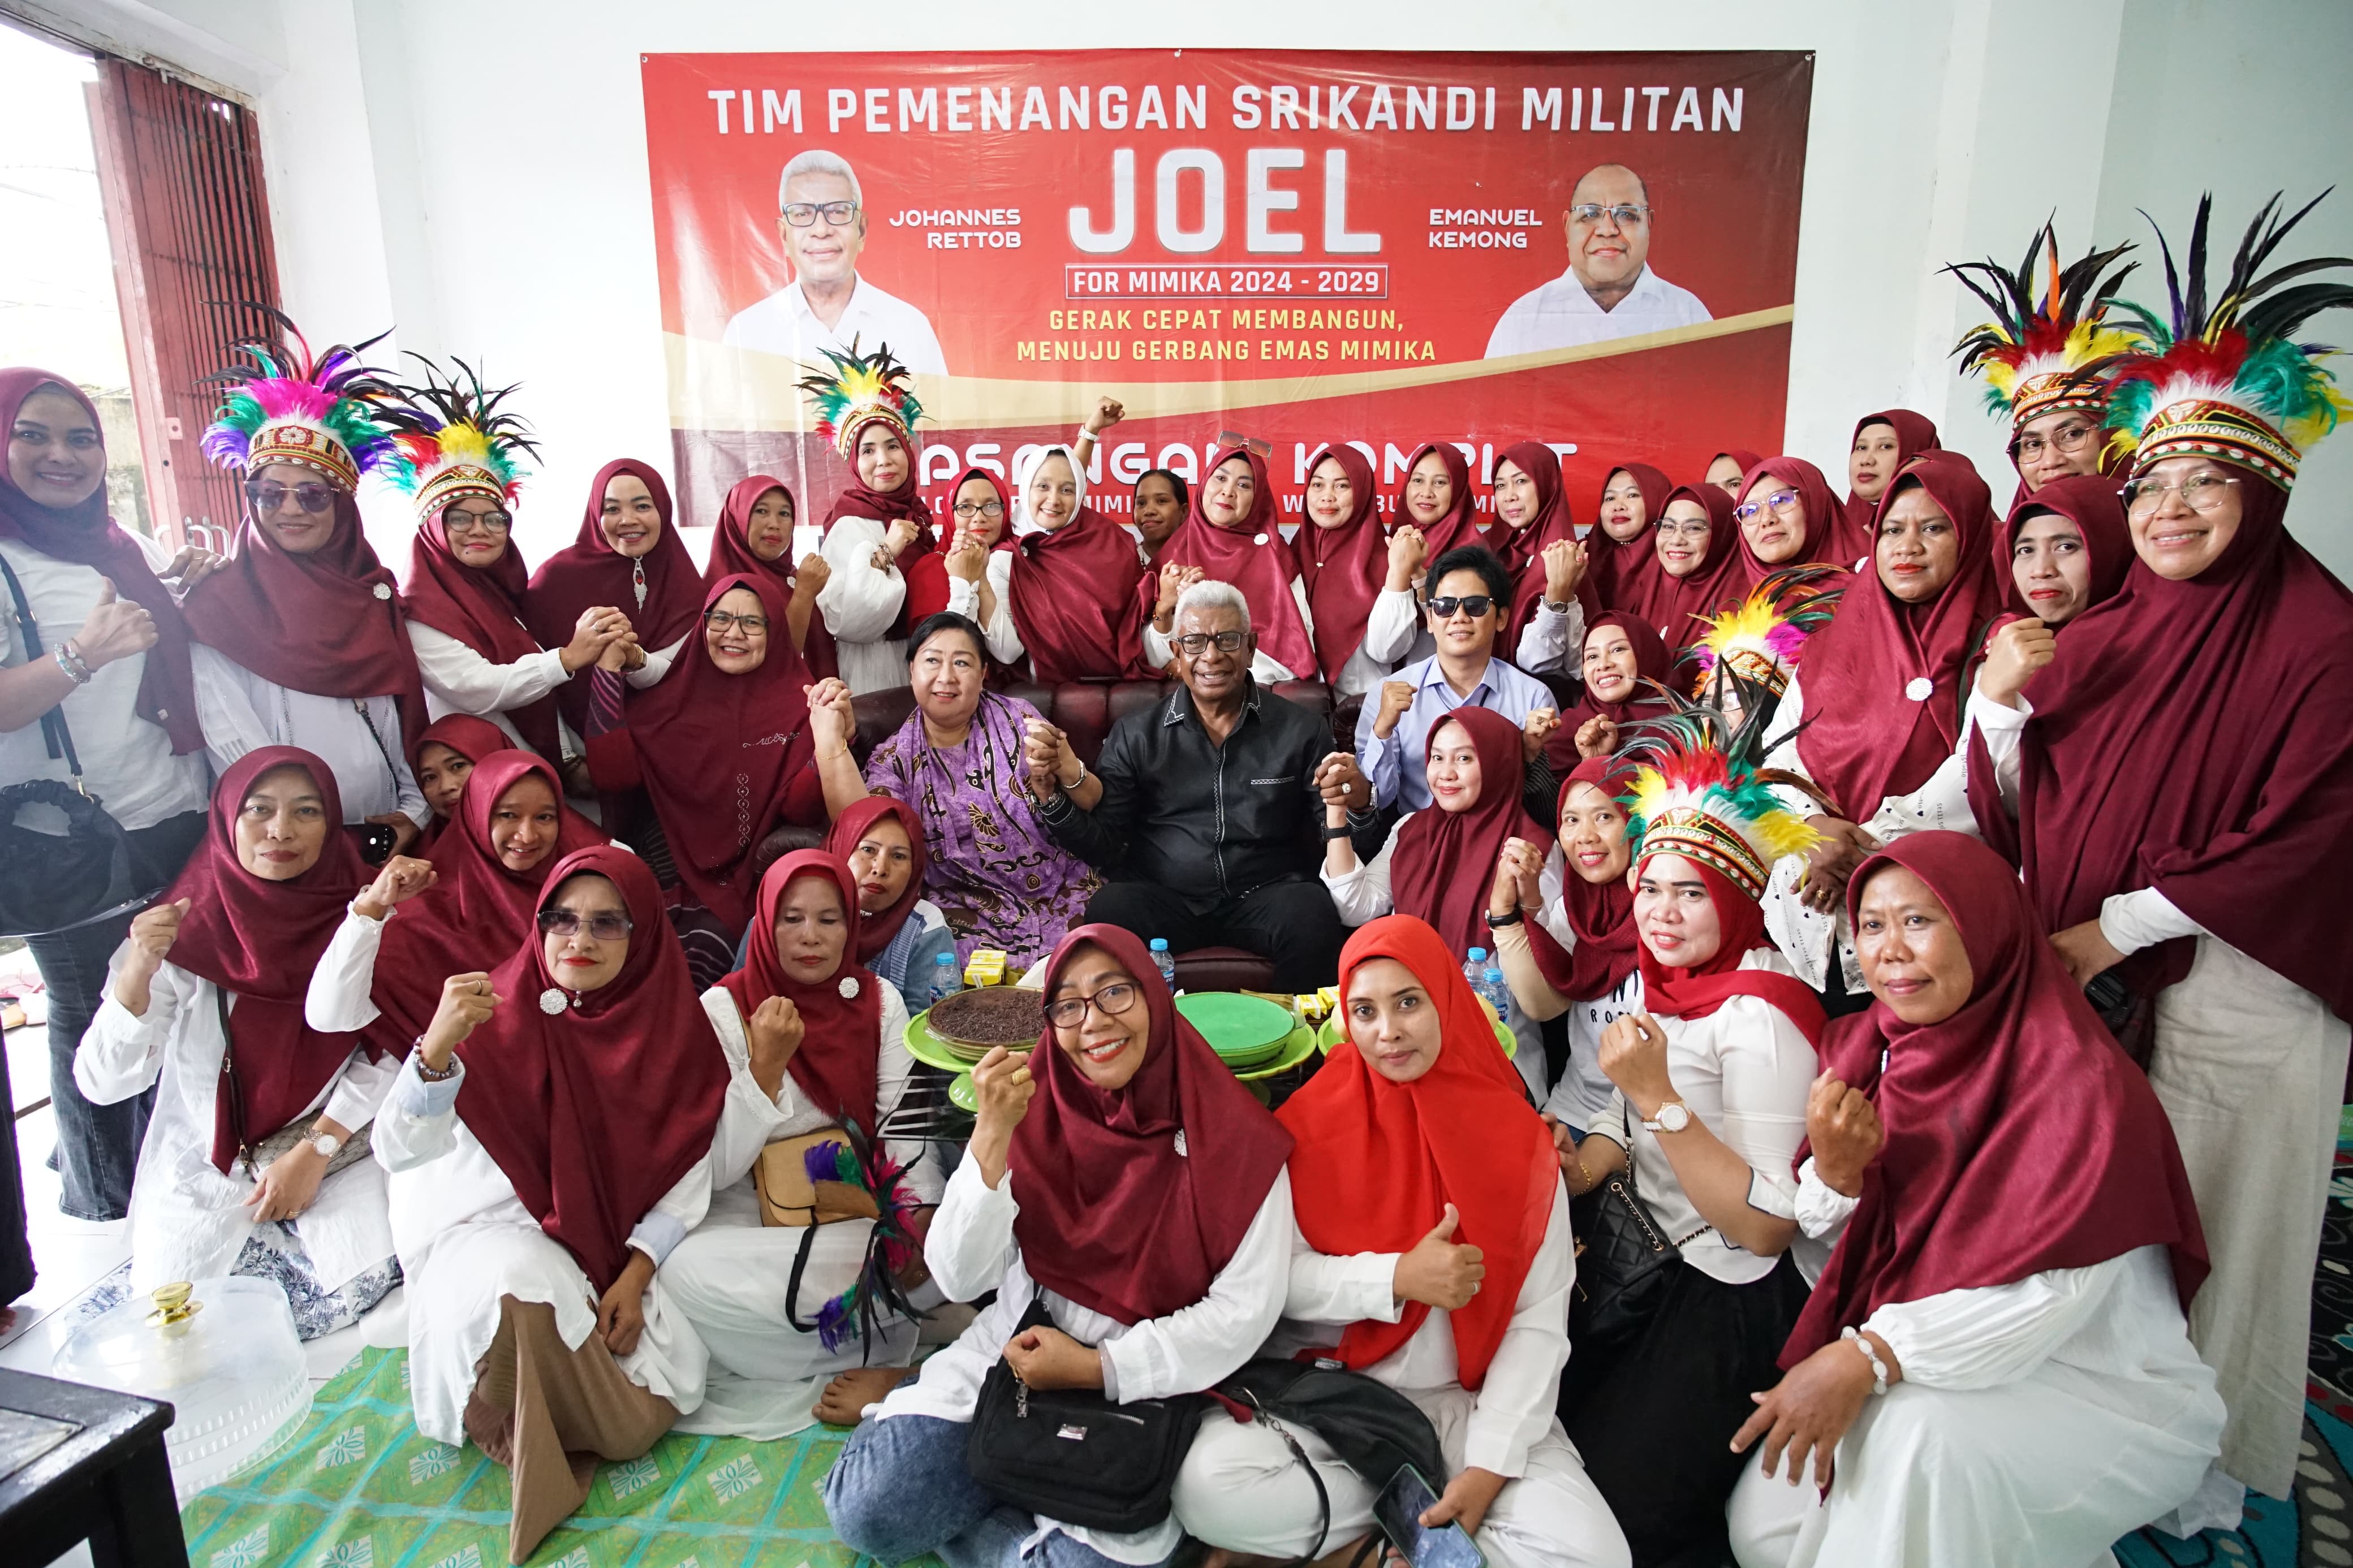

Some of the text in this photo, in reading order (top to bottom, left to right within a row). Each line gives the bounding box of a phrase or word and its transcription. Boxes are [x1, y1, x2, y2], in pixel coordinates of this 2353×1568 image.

[708, 85, 1743, 134] TIM PEMENANGAN SRIKANDI MILITAN
[1068, 148, 1381, 254] JOEL
[889, 209, 1021, 227] JOHANNES
[1429, 209, 1542, 226] EMANUEL
[927, 231, 1022, 249] RETTOB
[1429, 231, 1527, 249] KEMONG
[1074, 271, 1119, 293] FOR
[1129, 271, 1222, 293] MIMIKA
[1231, 271, 1292, 292] 2024
[1318, 271, 1378, 292] 2029
[1049, 309, 1403, 332] GERAK CEPAT MEMBANGUN,
[1017, 340, 1436, 361] MENUJU GERBANG EMAS MIMIKA
